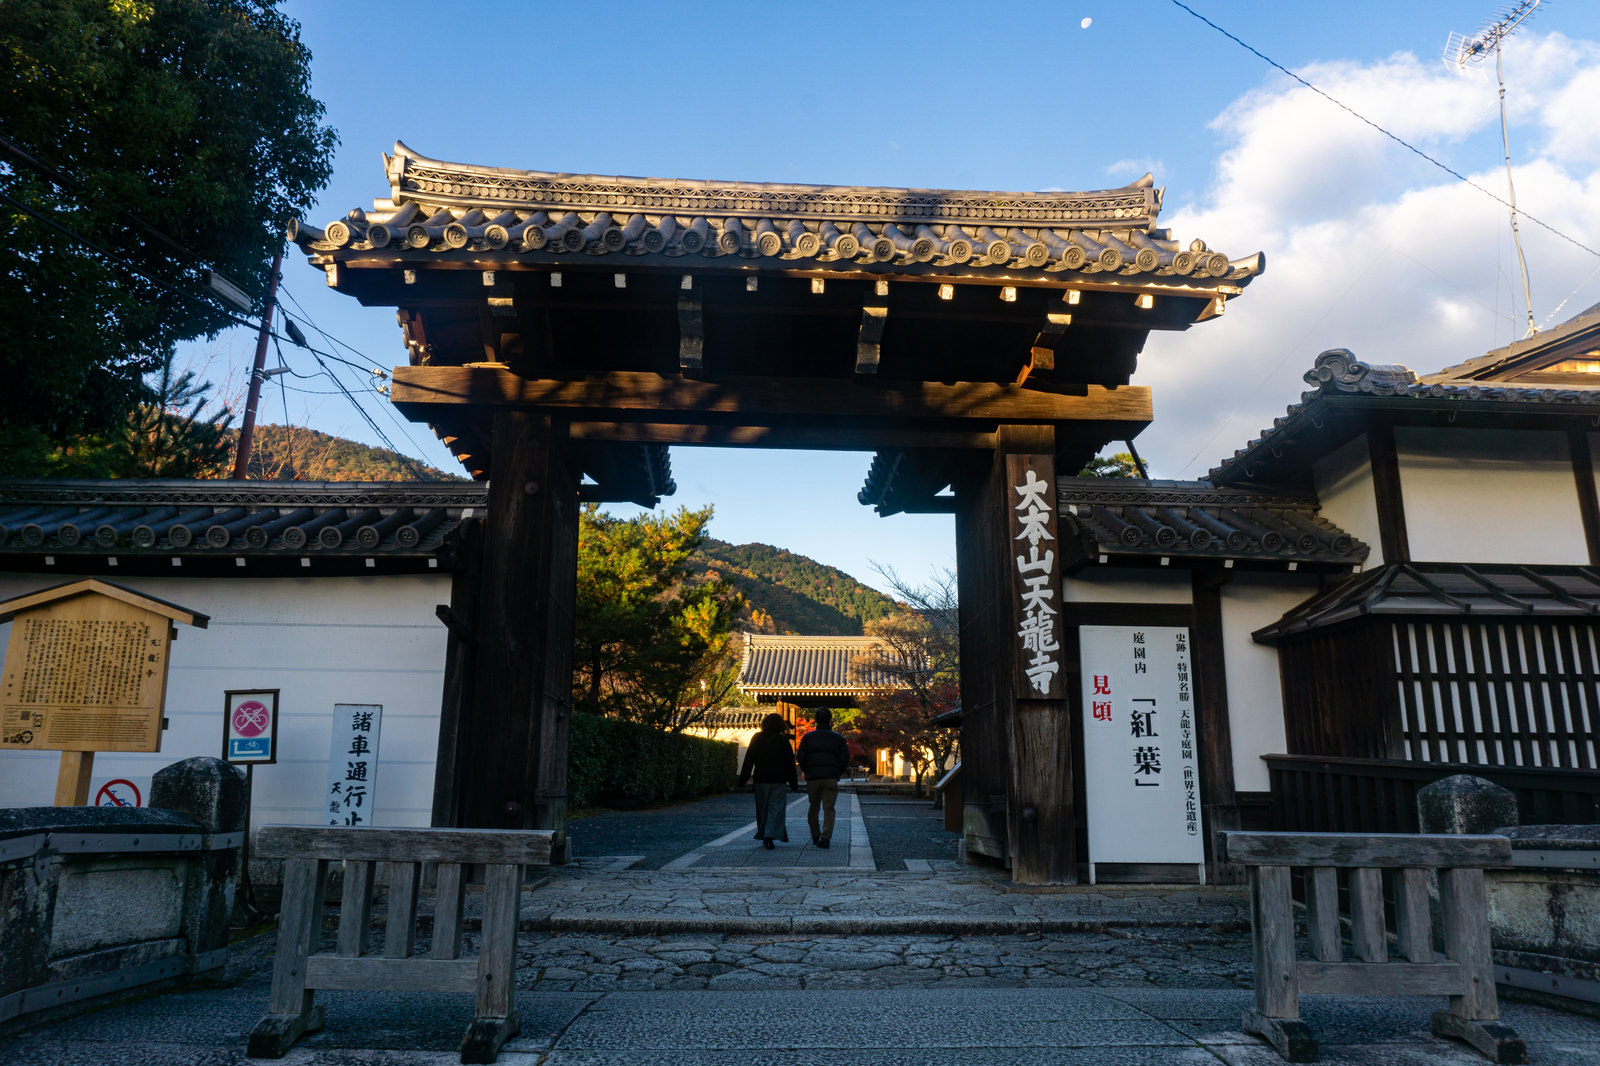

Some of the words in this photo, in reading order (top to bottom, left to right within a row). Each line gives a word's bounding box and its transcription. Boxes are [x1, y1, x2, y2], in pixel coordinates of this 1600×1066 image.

[1014, 469, 1061, 695] 大本山天龍寺
[1133, 632, 1147, 674] 庭園内
[1175, 633, 1190, 702] 史跡・特別名勝
[1092, 674, 1113, 722] 見頃
[343, 711, 374, 826] 諸車通行止
[1130, 698, 1162, 787] 「紅葉」
[1180, 709, 1193, 760] 天龍寺庭園
